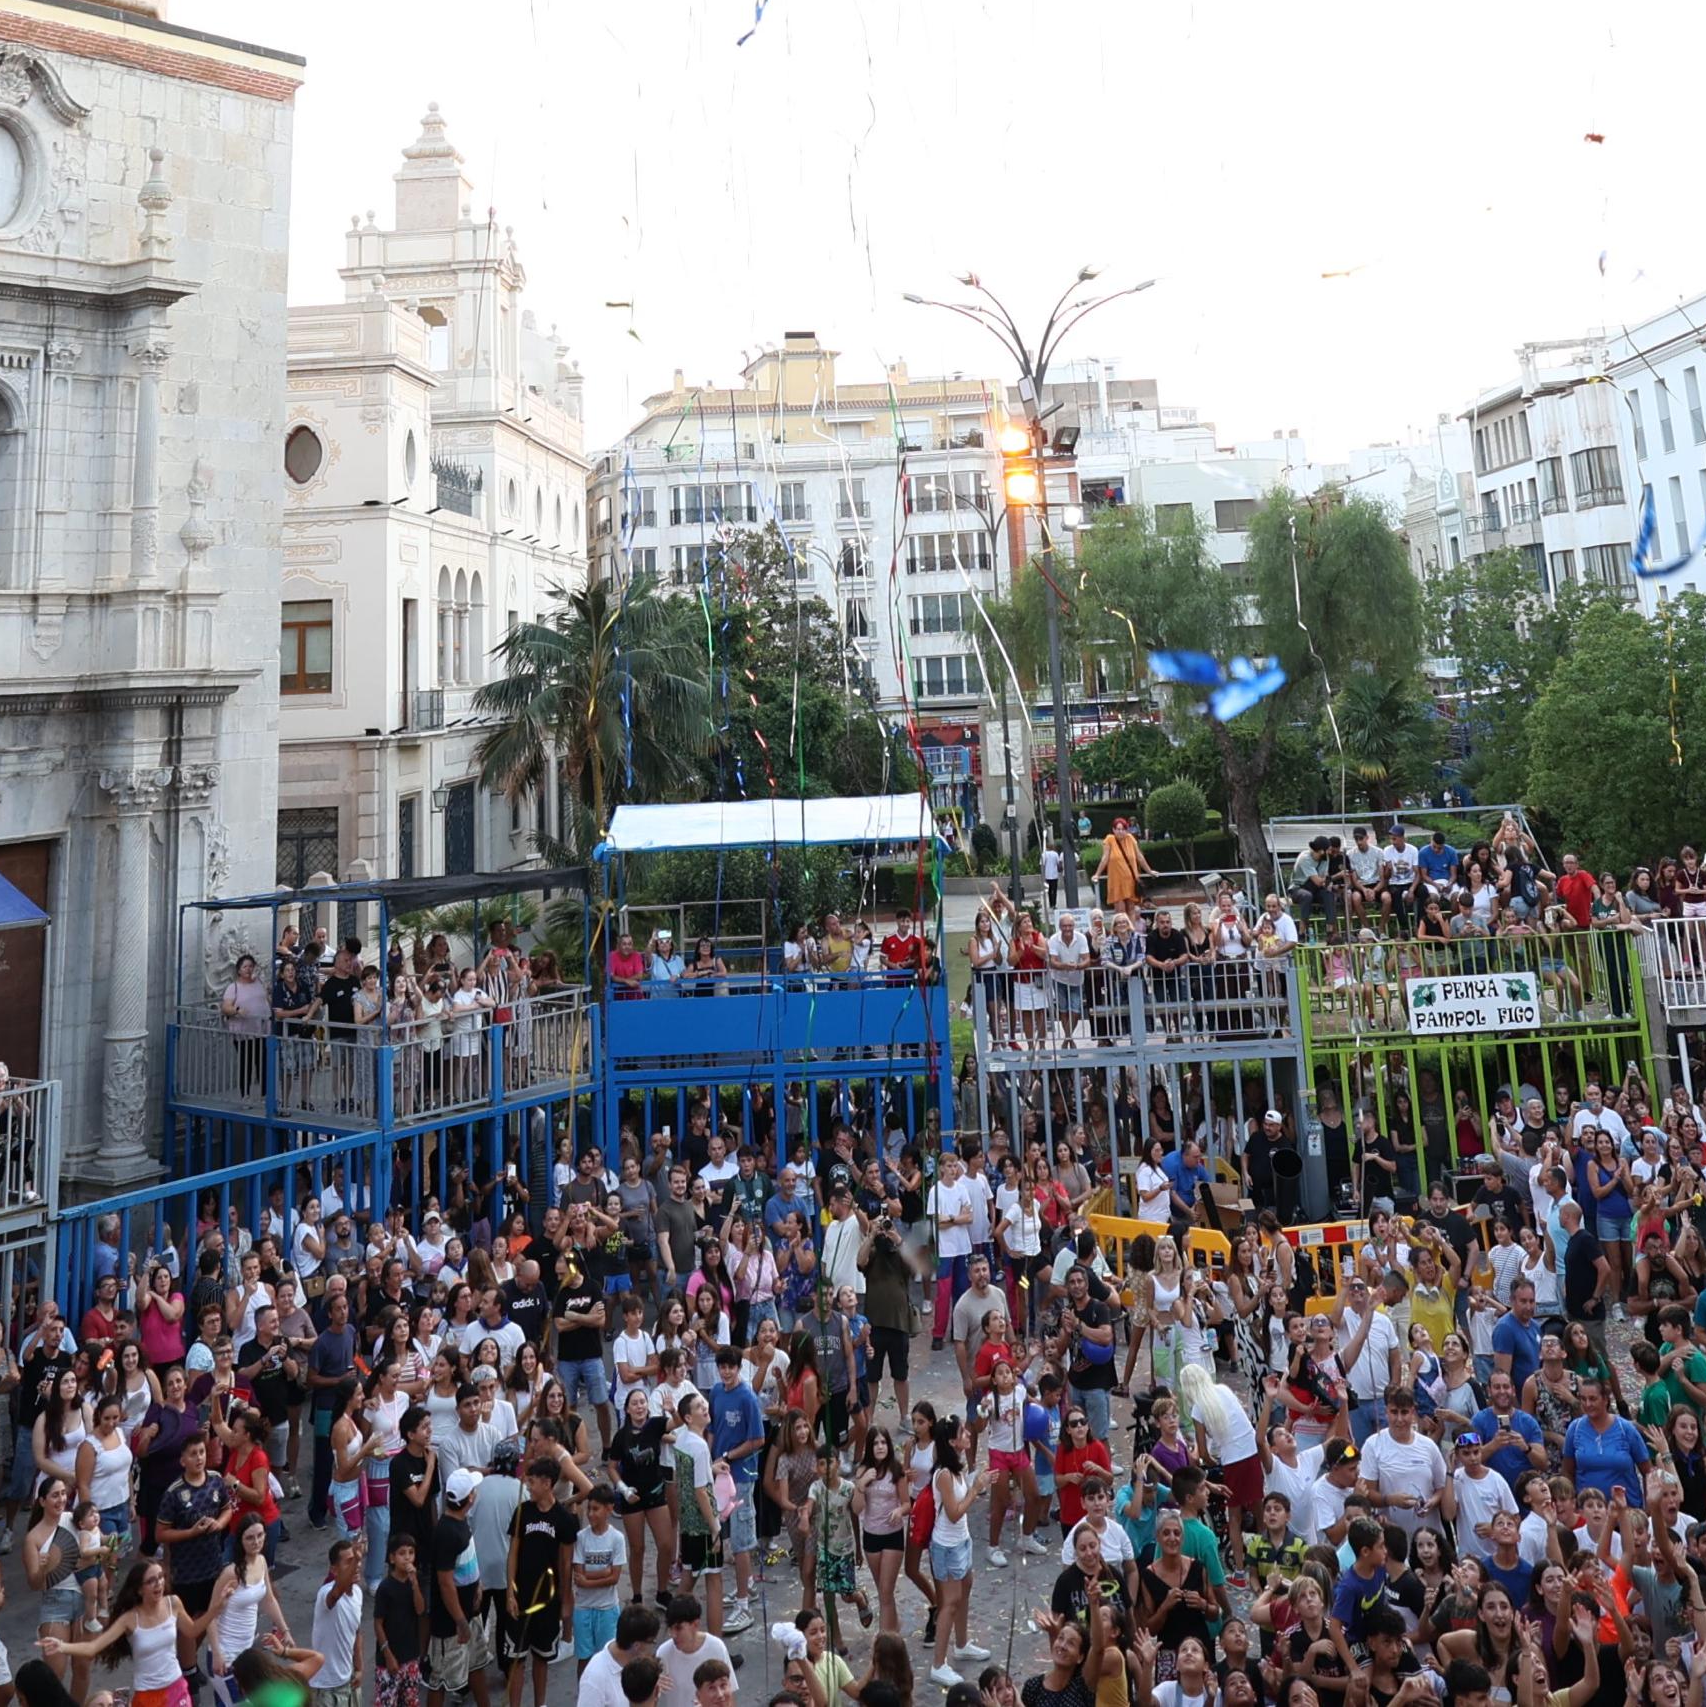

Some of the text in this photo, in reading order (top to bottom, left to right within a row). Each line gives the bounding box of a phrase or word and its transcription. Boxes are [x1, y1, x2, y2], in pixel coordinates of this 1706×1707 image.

[1441, 979, 1500, 1000] PENYA
[1414, 1006, 1534, 1029] PAMPOL FIGO
